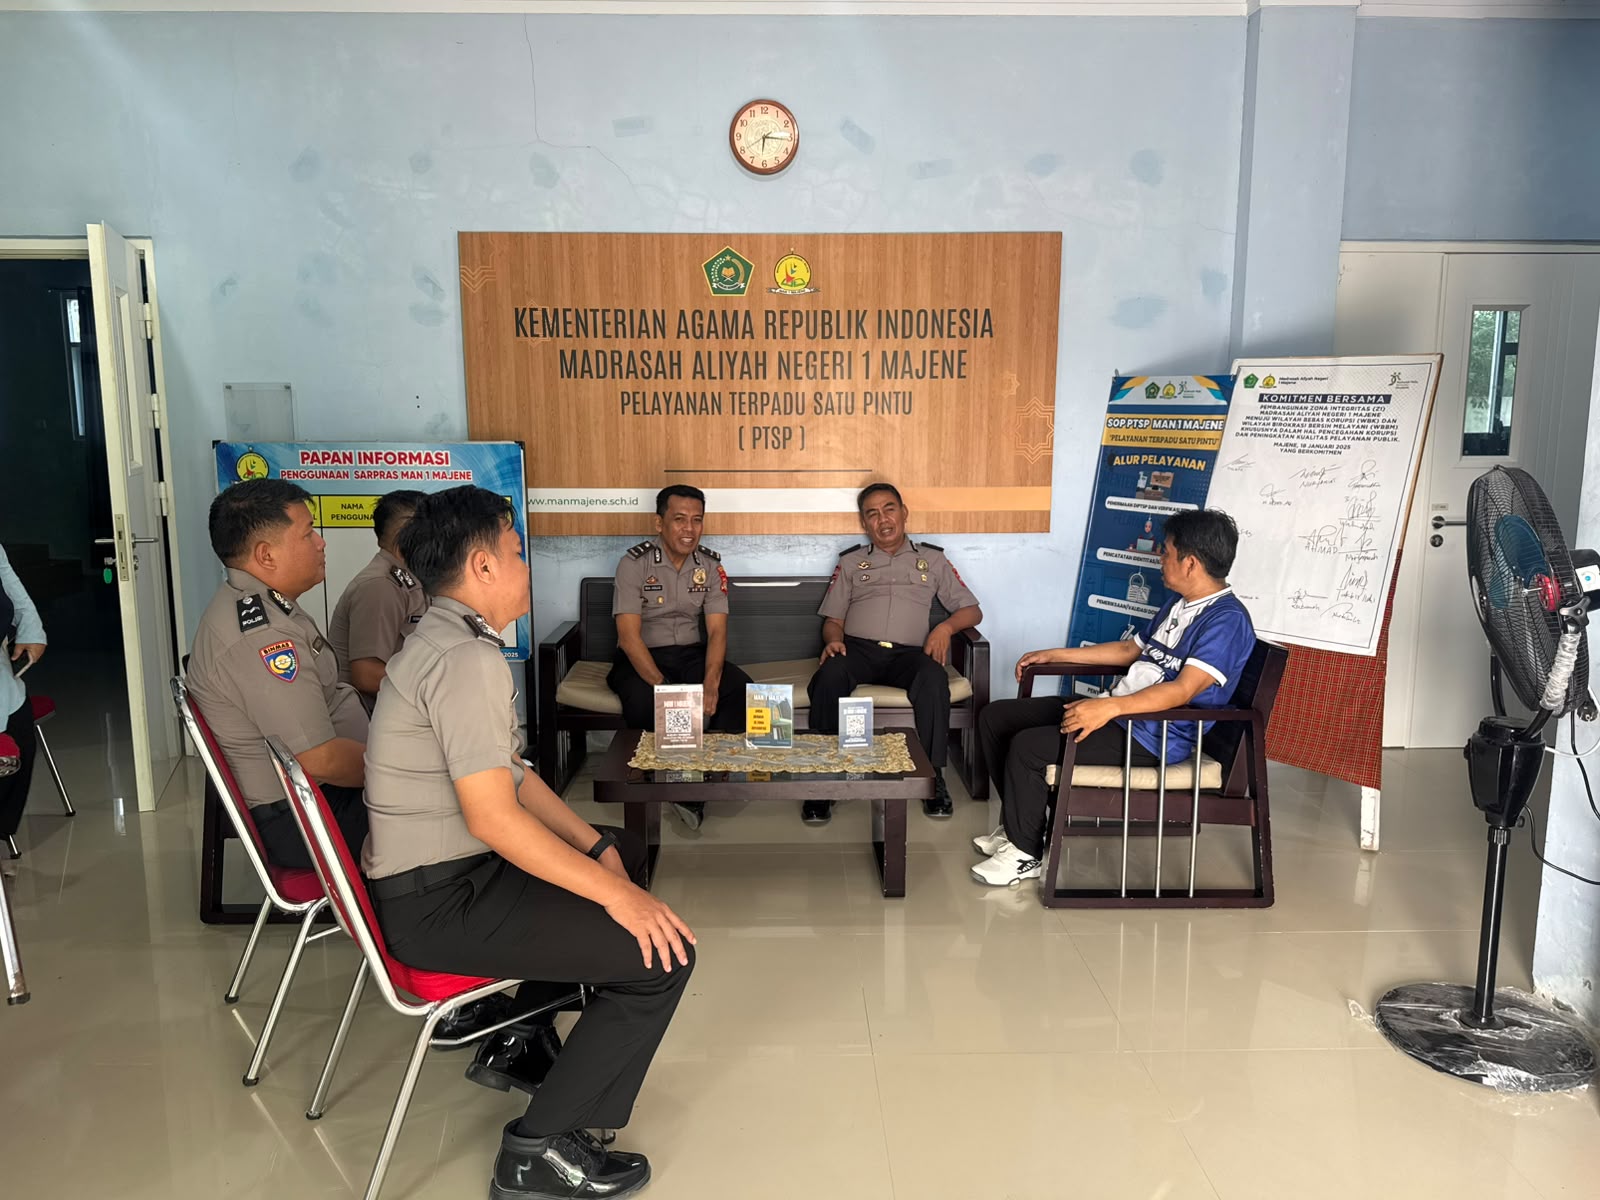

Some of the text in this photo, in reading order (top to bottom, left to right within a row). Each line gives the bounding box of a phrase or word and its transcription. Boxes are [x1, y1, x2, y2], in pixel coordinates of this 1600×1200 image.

[760, 106, 768, 114] 12
[784, 120, 789, 128] 2
[736, 133, 741, 141] 9
[762, 160, 767, 168] 6
[514, 307, 994, 340] KEMENTERIAN AGAMA REPUBLIK INDONESIA
[559, 349, 967, 380] MADRASAH ALIYAH NEGERI 1 MAJENE
[620, 390, 913, 416] PELAYANAN TERPADU SATU PINTU
[1326, 395, 1385, 403] BERSAMA
[1153, 420, 1176, 429] MAN
[1183, 420, 1224, 430] MAJENE
[752, 426, 793, 450] PTSP
[1149, 436, 1178, 444] TERPADU
[300, 451, 450, 466] PAPAN INFORMASI
[1113, 455, 1206, 471] ALUR PELAYANAN
[280, 470, 472, 480] PENGGUNAAN SARPRAS MAN 1 MAJENE
[242, 615, 263, 626] POLISI
[263, 642, 290, 654] BINMAS
